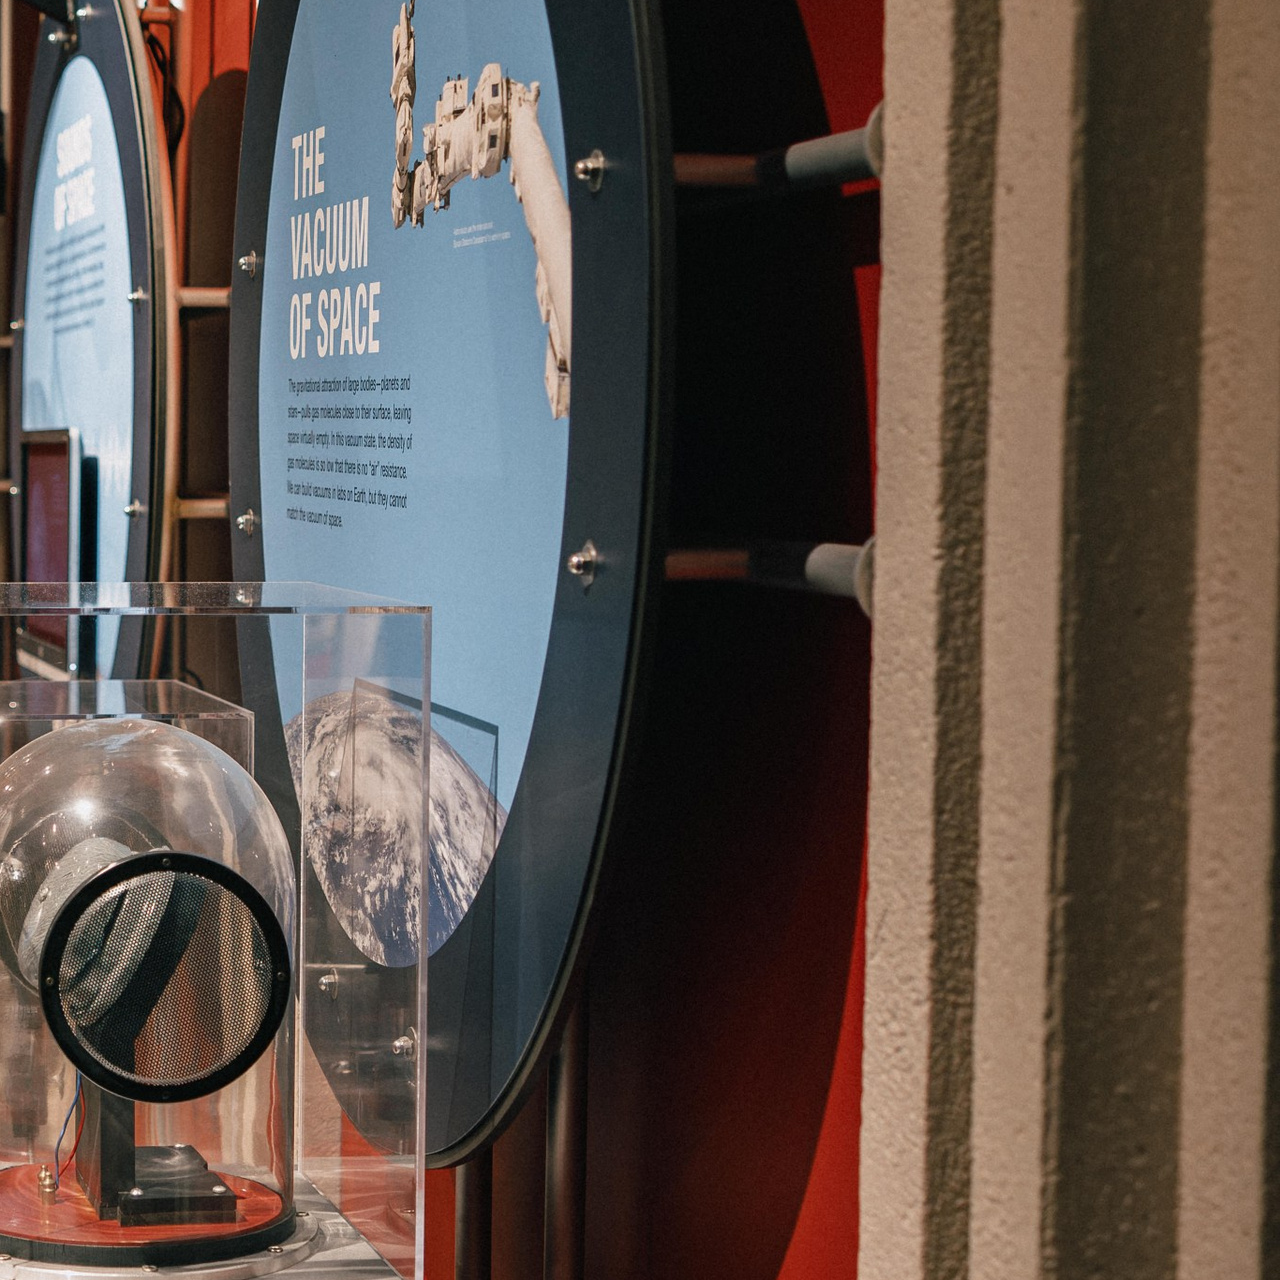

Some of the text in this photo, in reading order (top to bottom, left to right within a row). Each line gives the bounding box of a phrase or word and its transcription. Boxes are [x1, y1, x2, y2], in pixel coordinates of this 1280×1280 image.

[292, 126, 326, 200] THE
[290, 196, 369, 279] VACUUM
[289, 282, 381, 360] OF SPACE
[297, 378, 320, 396] gravitational
[322, 377, 341, 392] attraction
[343, 376, 347, 392] of
[348, 377, 359, 395] large
[400, 374, 410, 391] and
[320, 404, 341, 419] molecules
[342, 405, 354, 419] close
[355, 407, 360, 419] to
[361, 404, 371, 419] their
[373, 404, 392, 422] surface,
[393, 404, 411, 424] leaving
[331, 431, 335, 445] In
[336, 432, 344, 446] this
[345, 435, 362, 446] vacuum
[364, 434, 377, 450] state,
[378, 433, 386, 448] the
[387, 434, 405, 453] density
[407, 434, 413, 449] of
[295, 456, 315, 471] molecules
[316, 457, 319, 471] is
[320, 461, 325, 472] so
[326, 458, 334, 473] low
[335, 459, 344, 473] that
[344, 459, 356, 474] there
[357, 459, 360, 474] is
[362, 464, 368, 475] no
[380, 461, 408, 479] resistance.
[302, 482, 312, 496] build
[313, 486, 331, 499] vacuums
[332, 485, 336, 499] in
[337, 485, 346, 501] labs
[347, 489, 353, 501] on
[354, 487, 367, 506] Earth,
[368, 489, 376, 505] but
[378, 490, 388, 510] they
[389, 493, 407, 508] cannot
[307, 511, 322, 523] vacuum
[324, 510, 328, 525] of
[329, 515, 343, 529] space.
